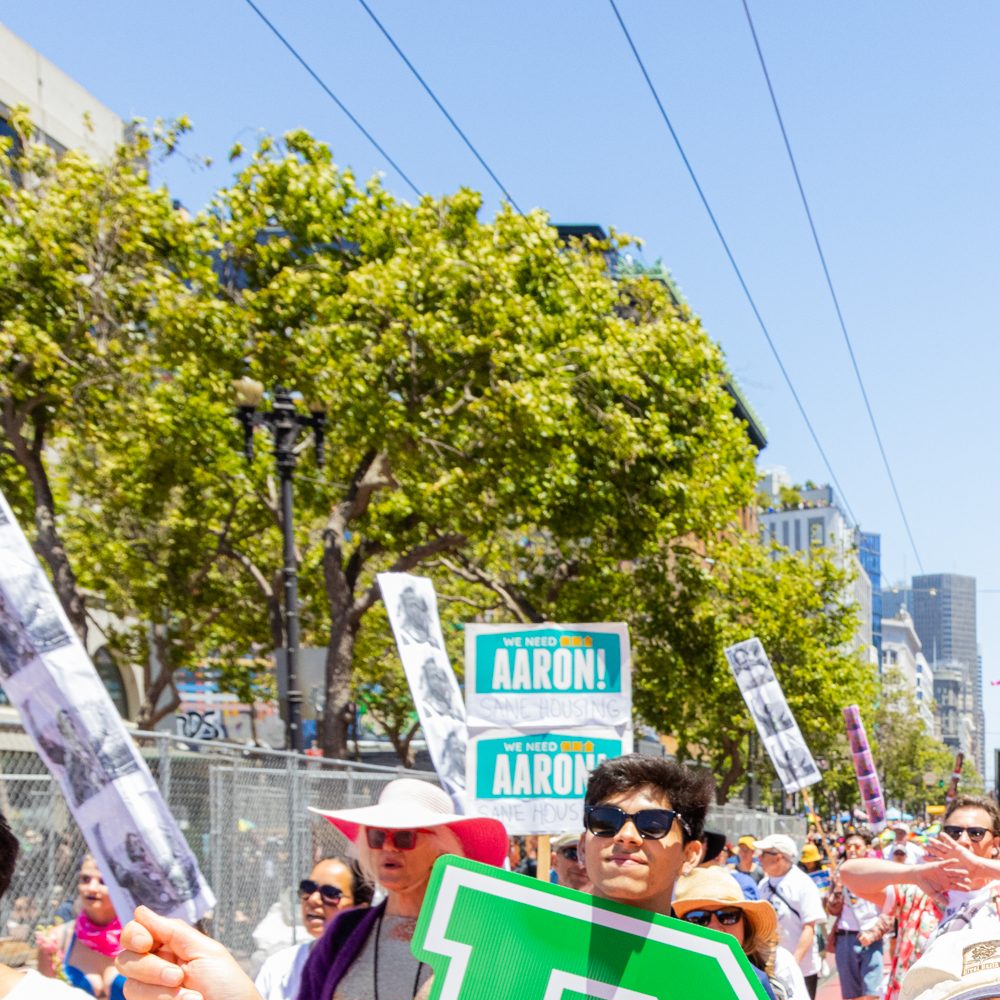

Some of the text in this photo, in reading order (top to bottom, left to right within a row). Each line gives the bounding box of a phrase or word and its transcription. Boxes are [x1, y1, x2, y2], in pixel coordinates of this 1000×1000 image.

[503, 636, 557, 647] WE NEED
[491, 648, 606, 690] AARON!
[479, 698, 620, 720] SANE HOUSING
[504, 742, 557, 752] WE NEED
[492, 753, 603, 795] AARON
